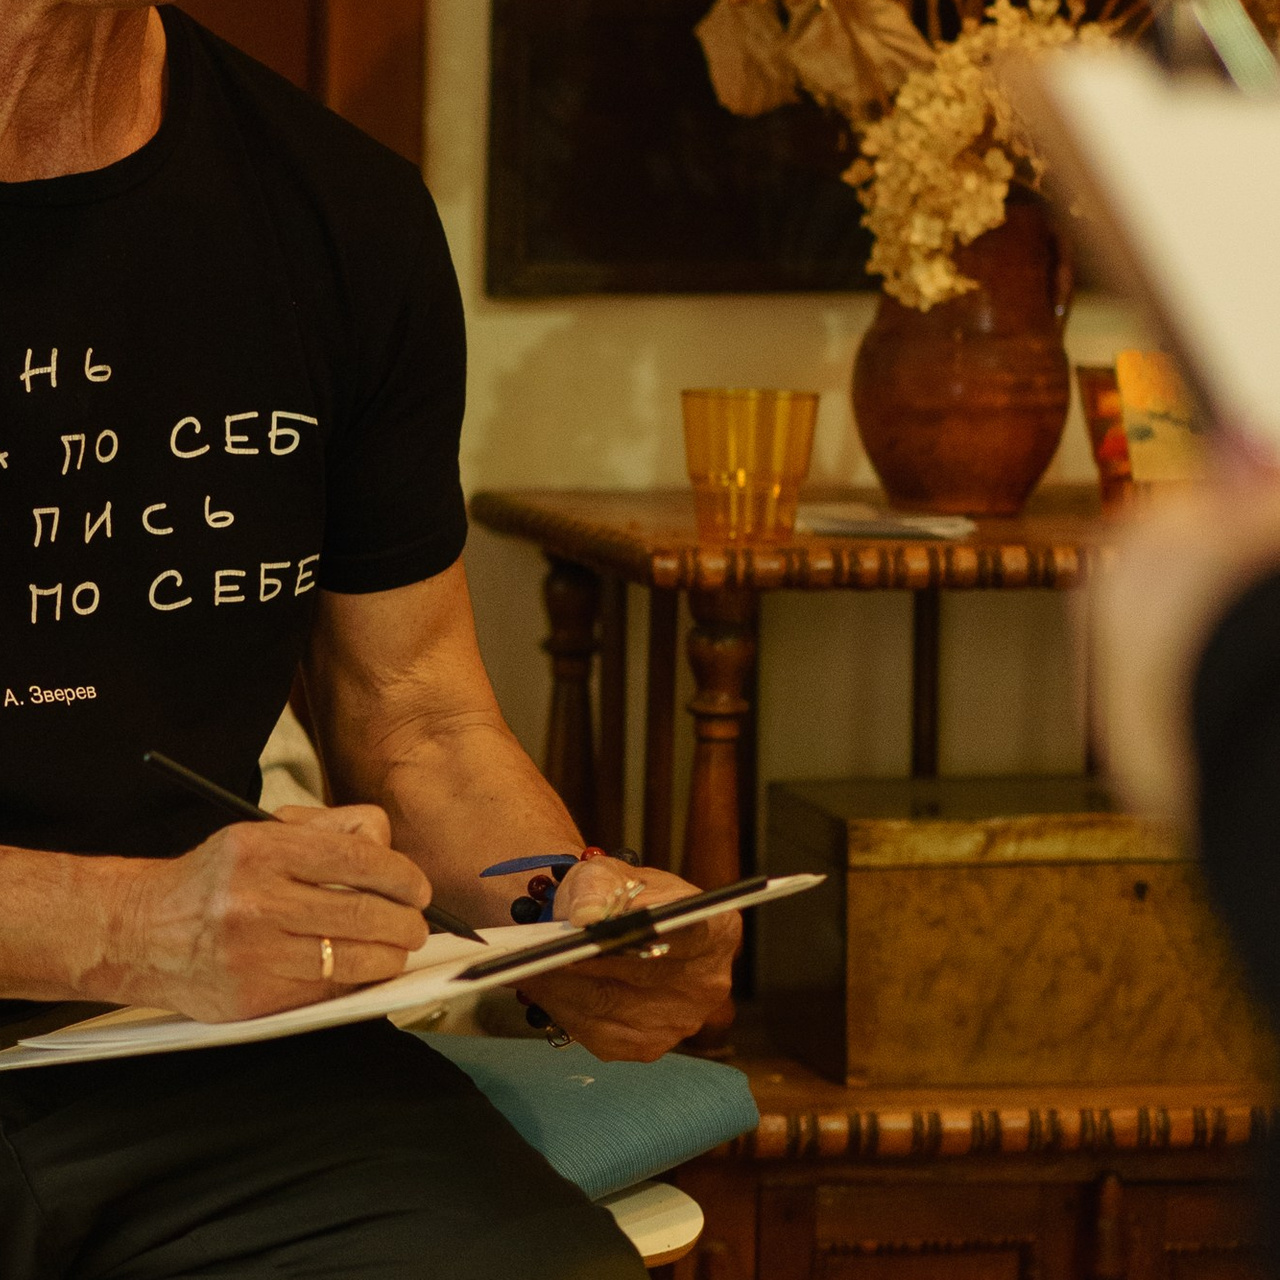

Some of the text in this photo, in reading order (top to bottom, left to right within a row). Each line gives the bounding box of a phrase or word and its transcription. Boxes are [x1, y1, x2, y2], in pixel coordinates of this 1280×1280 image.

[60, 429, 120, 476] ПО
[168, 410, 320, 460] СЕБ
[28, 581, 101, 625] ПО
[147, 552, 321, 612] СЕБЕ
[3, 684, 98, 708] А. Зверев
